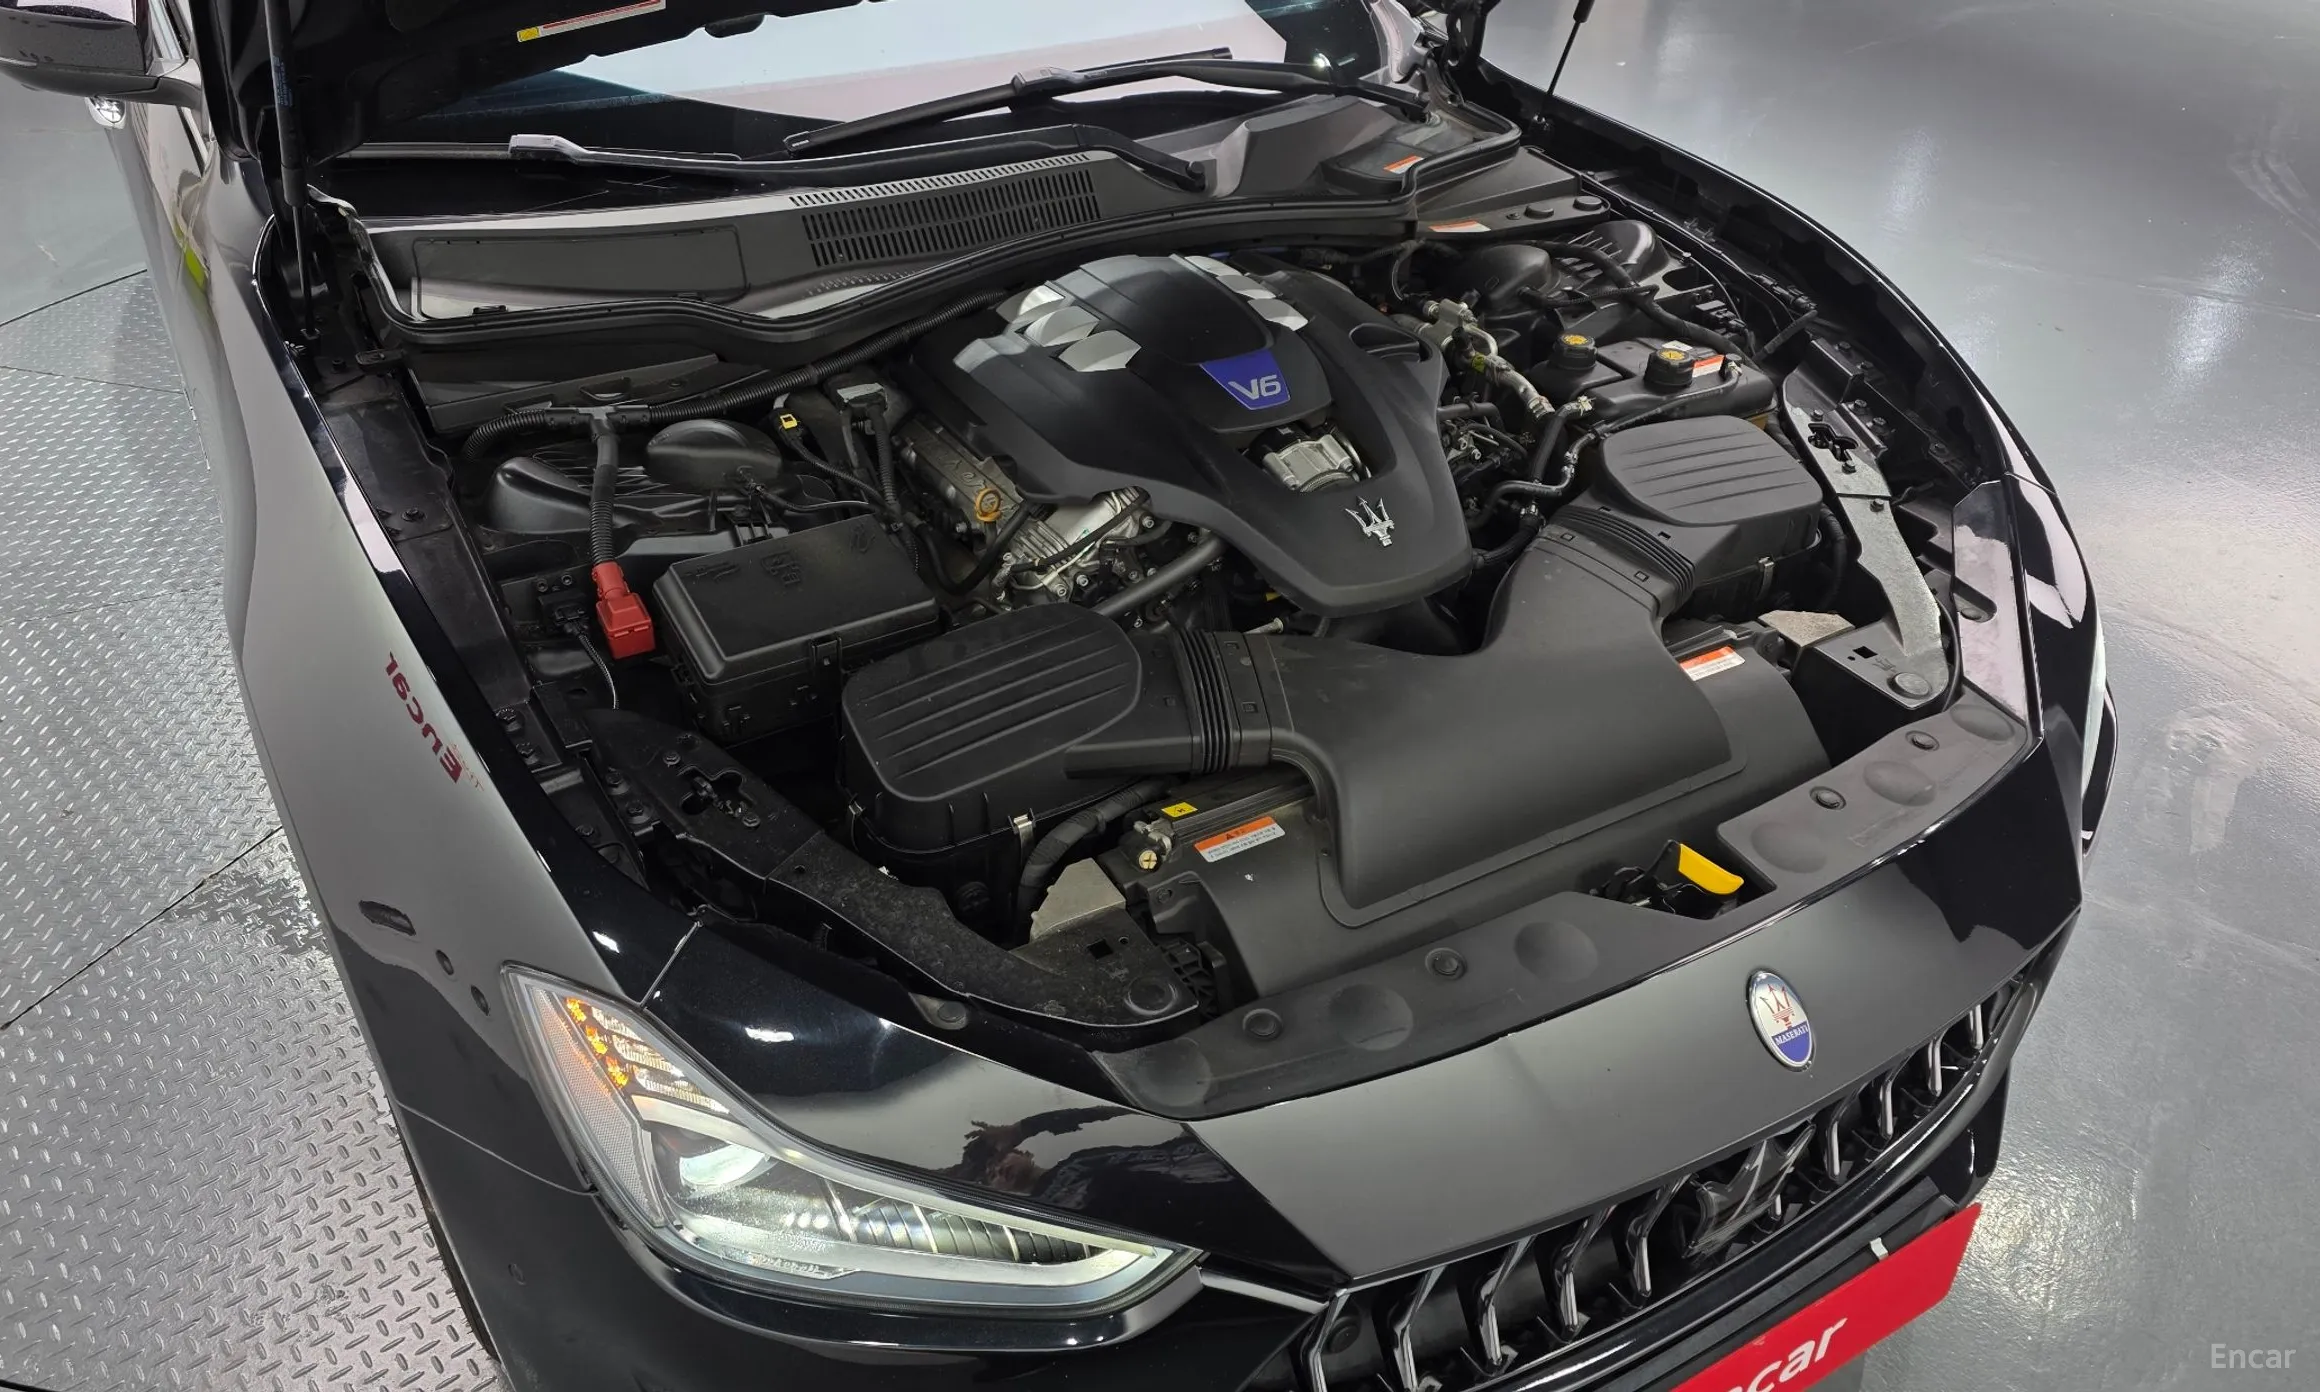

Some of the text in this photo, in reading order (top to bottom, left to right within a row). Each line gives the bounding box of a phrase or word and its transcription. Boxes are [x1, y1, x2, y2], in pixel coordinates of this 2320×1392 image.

[1228, 374, 1281, 400] V6
[1775, 1025, 1809, 1045] MASERATI
[1727, 1317, 1848, 1392] car
